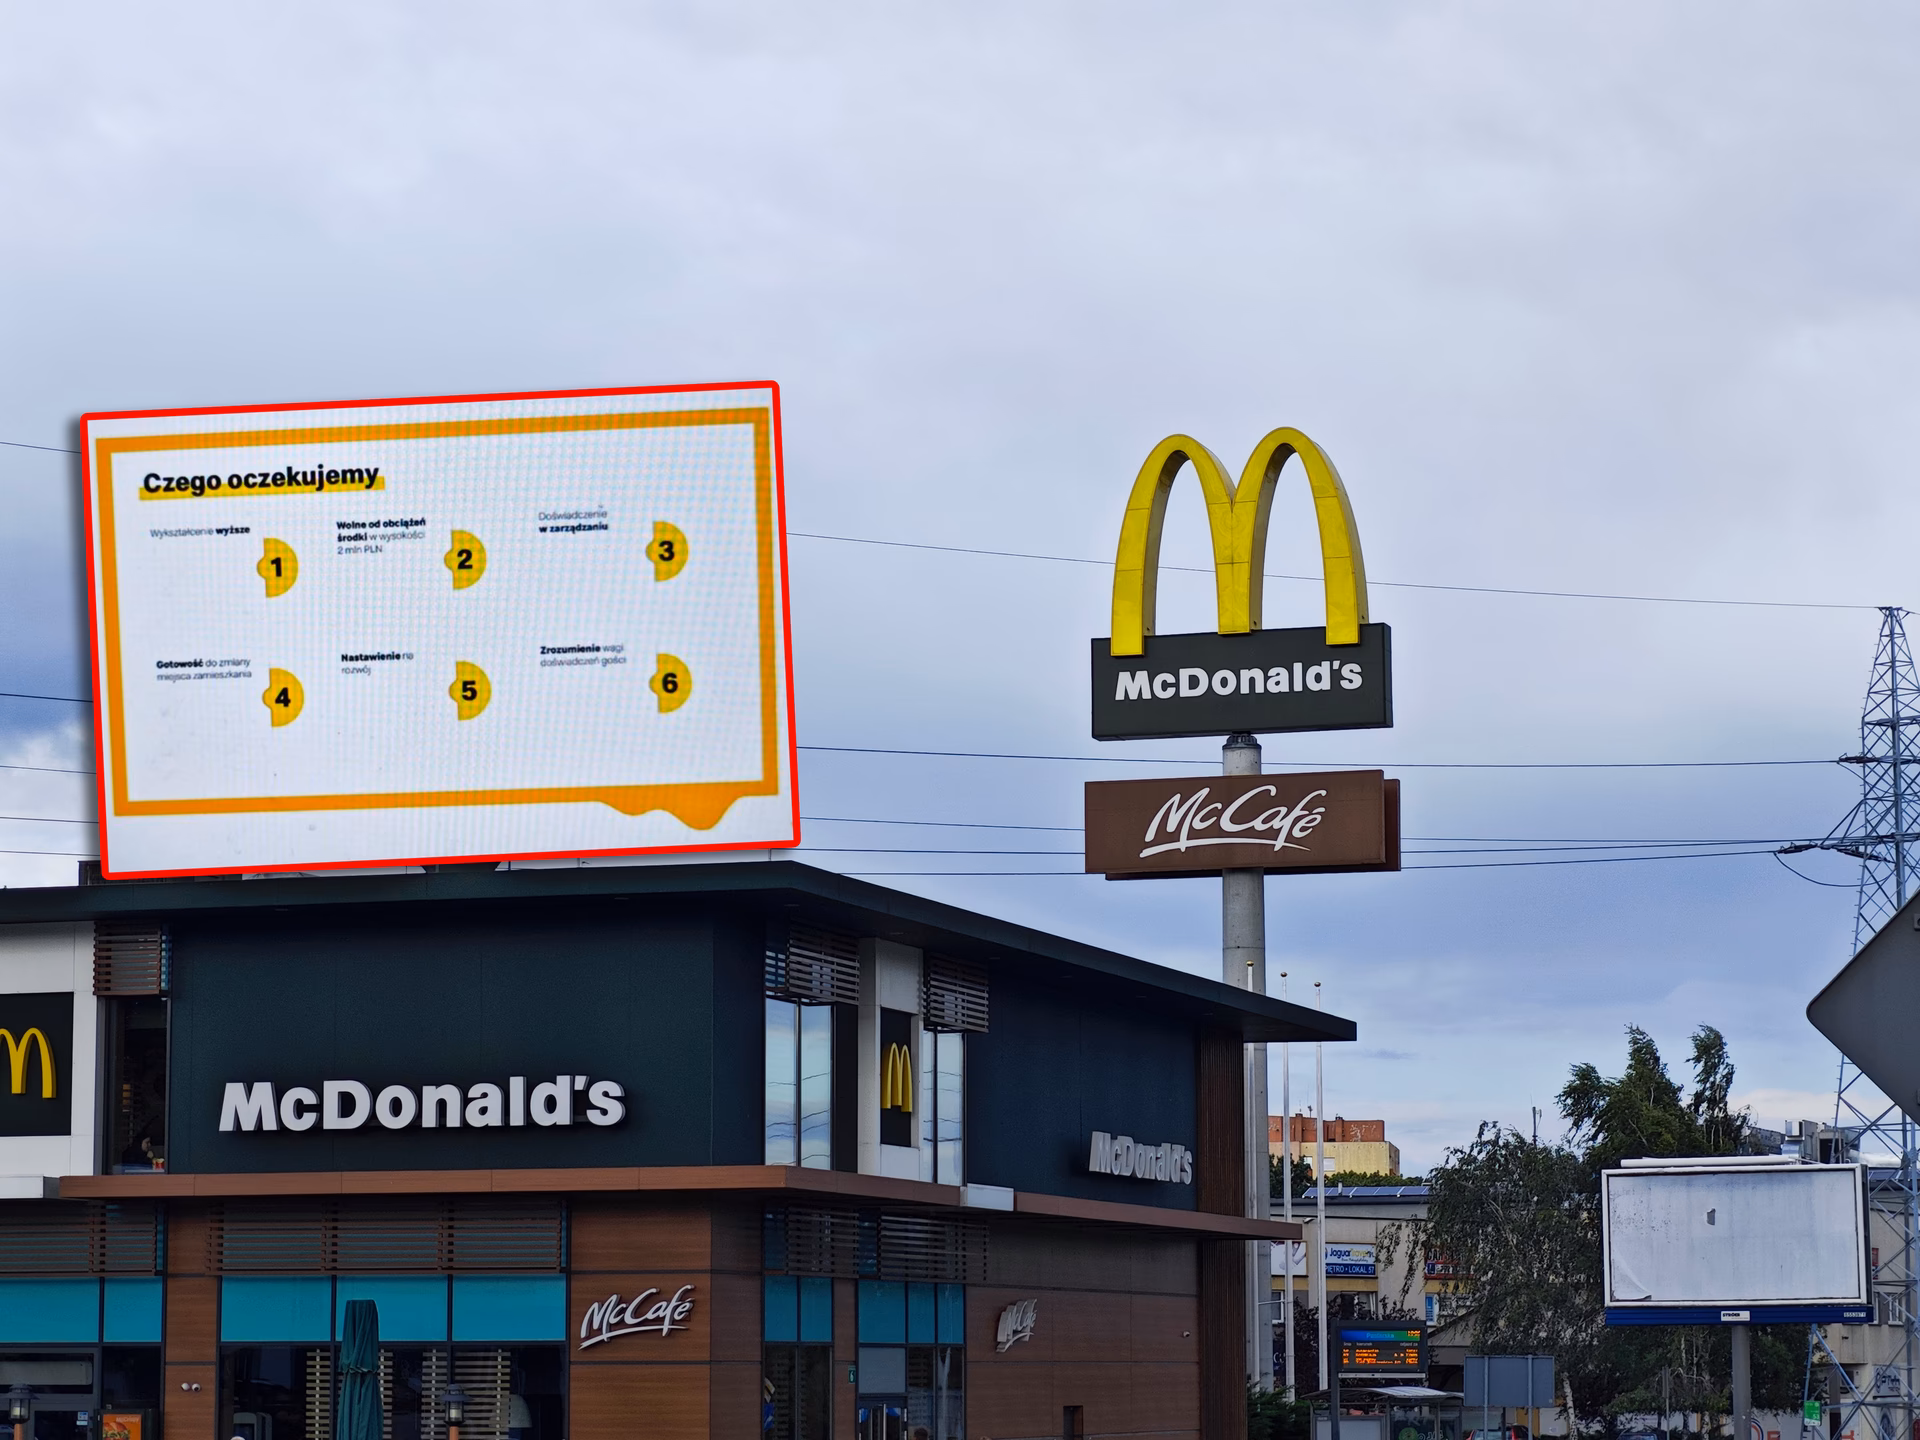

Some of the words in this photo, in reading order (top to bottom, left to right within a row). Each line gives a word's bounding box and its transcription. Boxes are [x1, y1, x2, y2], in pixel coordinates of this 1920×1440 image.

[1115, 659, 1363, 701] McDonald's
[1145, 784, 1328, 853] McCafé
[217, 1074, 626, 1132] McDonald's
[1088, 1130, 1193, 1186] McDonald's
[1349, 1265, 1367, 1274] LOKAL
[579, 1284, 695, 1340] McCafé
